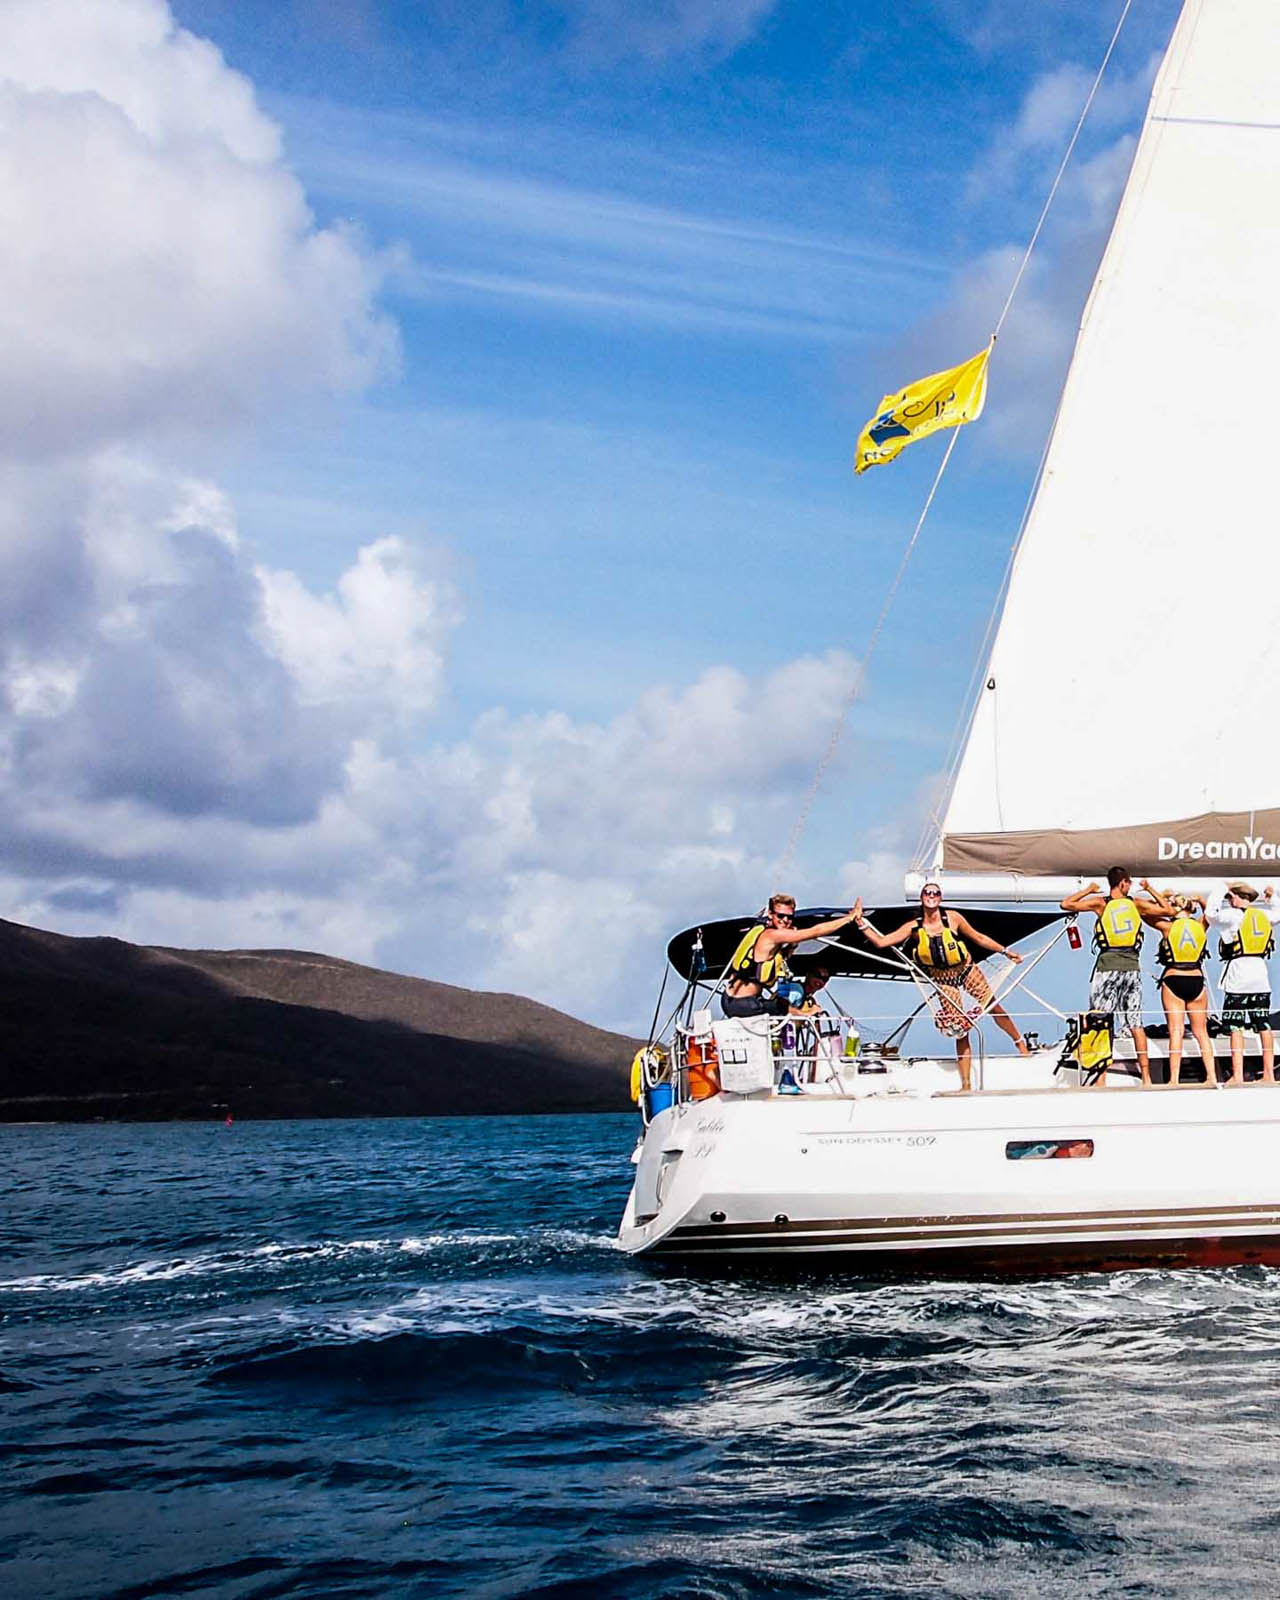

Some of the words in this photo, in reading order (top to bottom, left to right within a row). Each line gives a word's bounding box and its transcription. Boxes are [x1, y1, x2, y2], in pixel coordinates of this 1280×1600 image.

[1110, 906, 1134, 935] G
[1251, 915, 1265, 936] L
[1178, 927, 1197, 950] A
